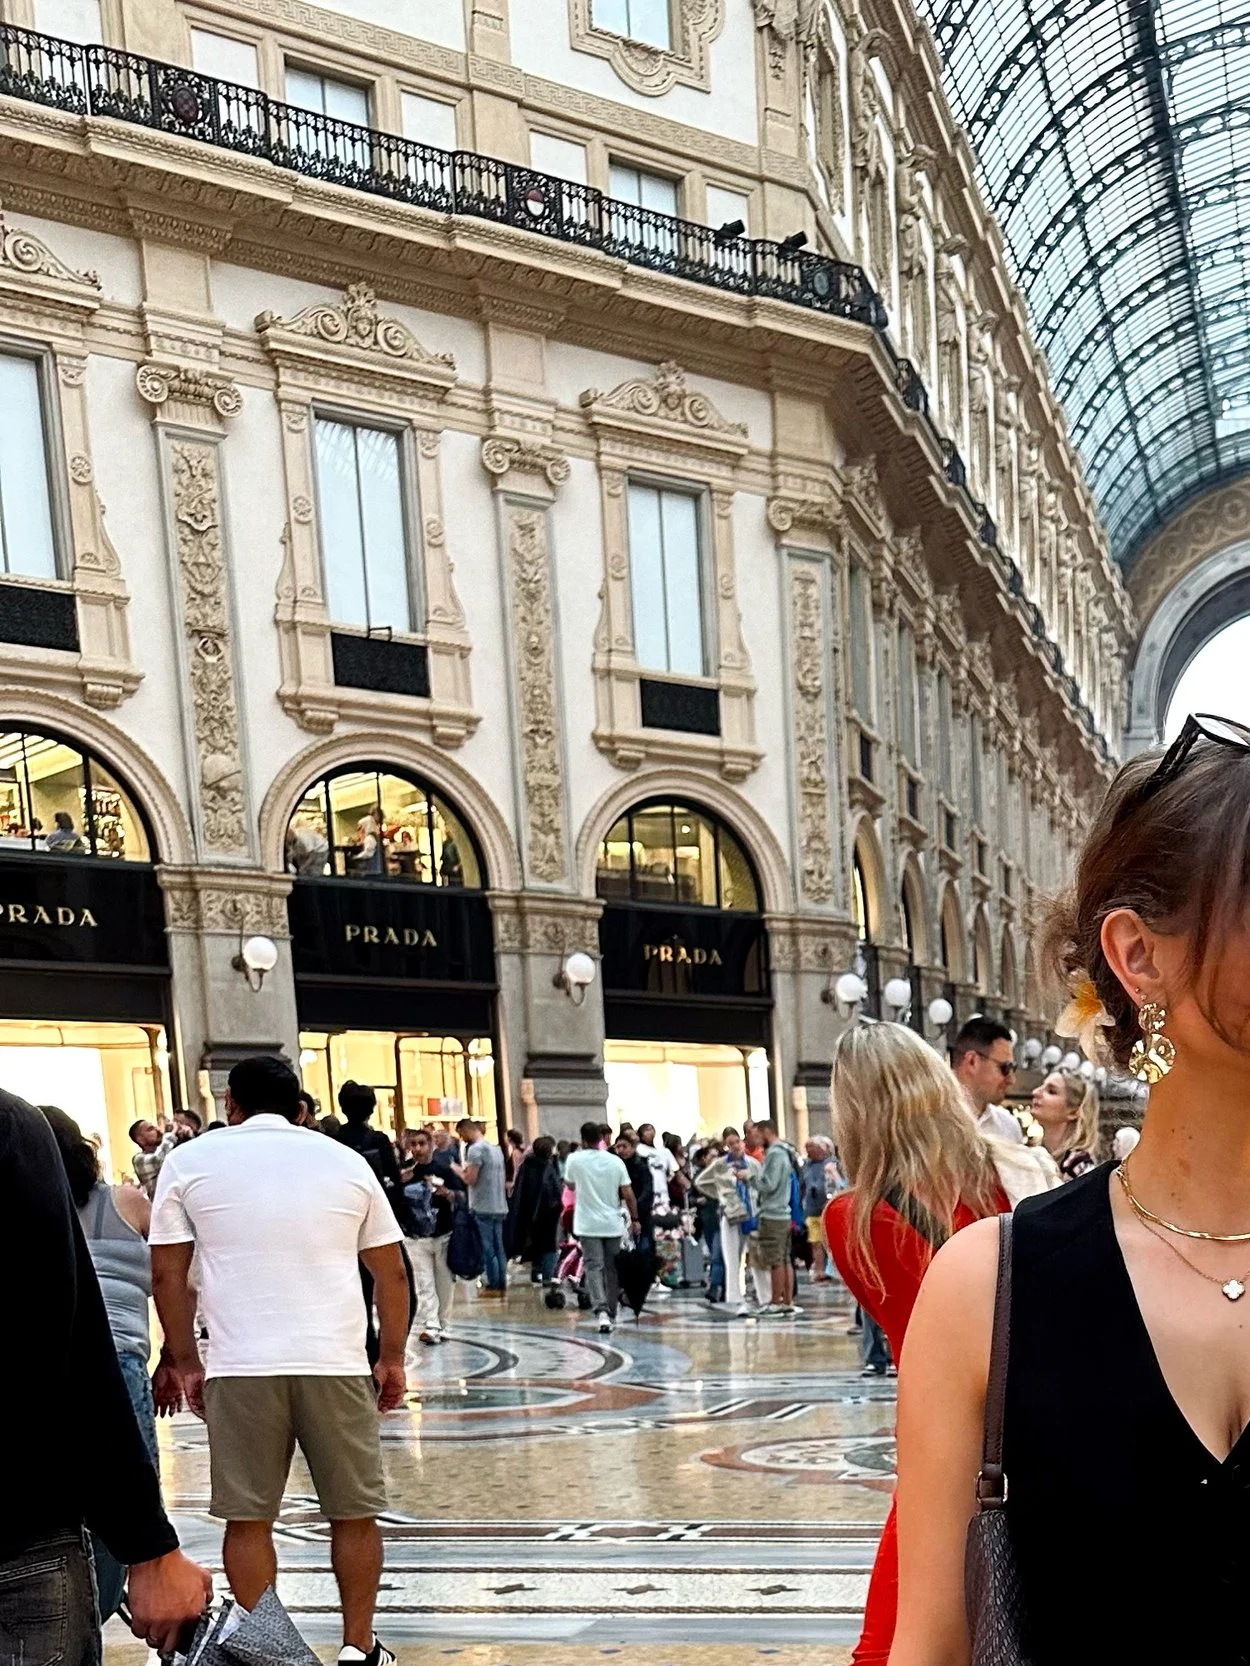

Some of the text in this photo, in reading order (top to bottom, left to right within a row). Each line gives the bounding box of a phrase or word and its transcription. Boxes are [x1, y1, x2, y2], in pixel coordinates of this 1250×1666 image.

[0, 903, 98, 927] RADA
[345, 924, 438, 947] PRADA
[643, 943, 722, 966] PRADA
